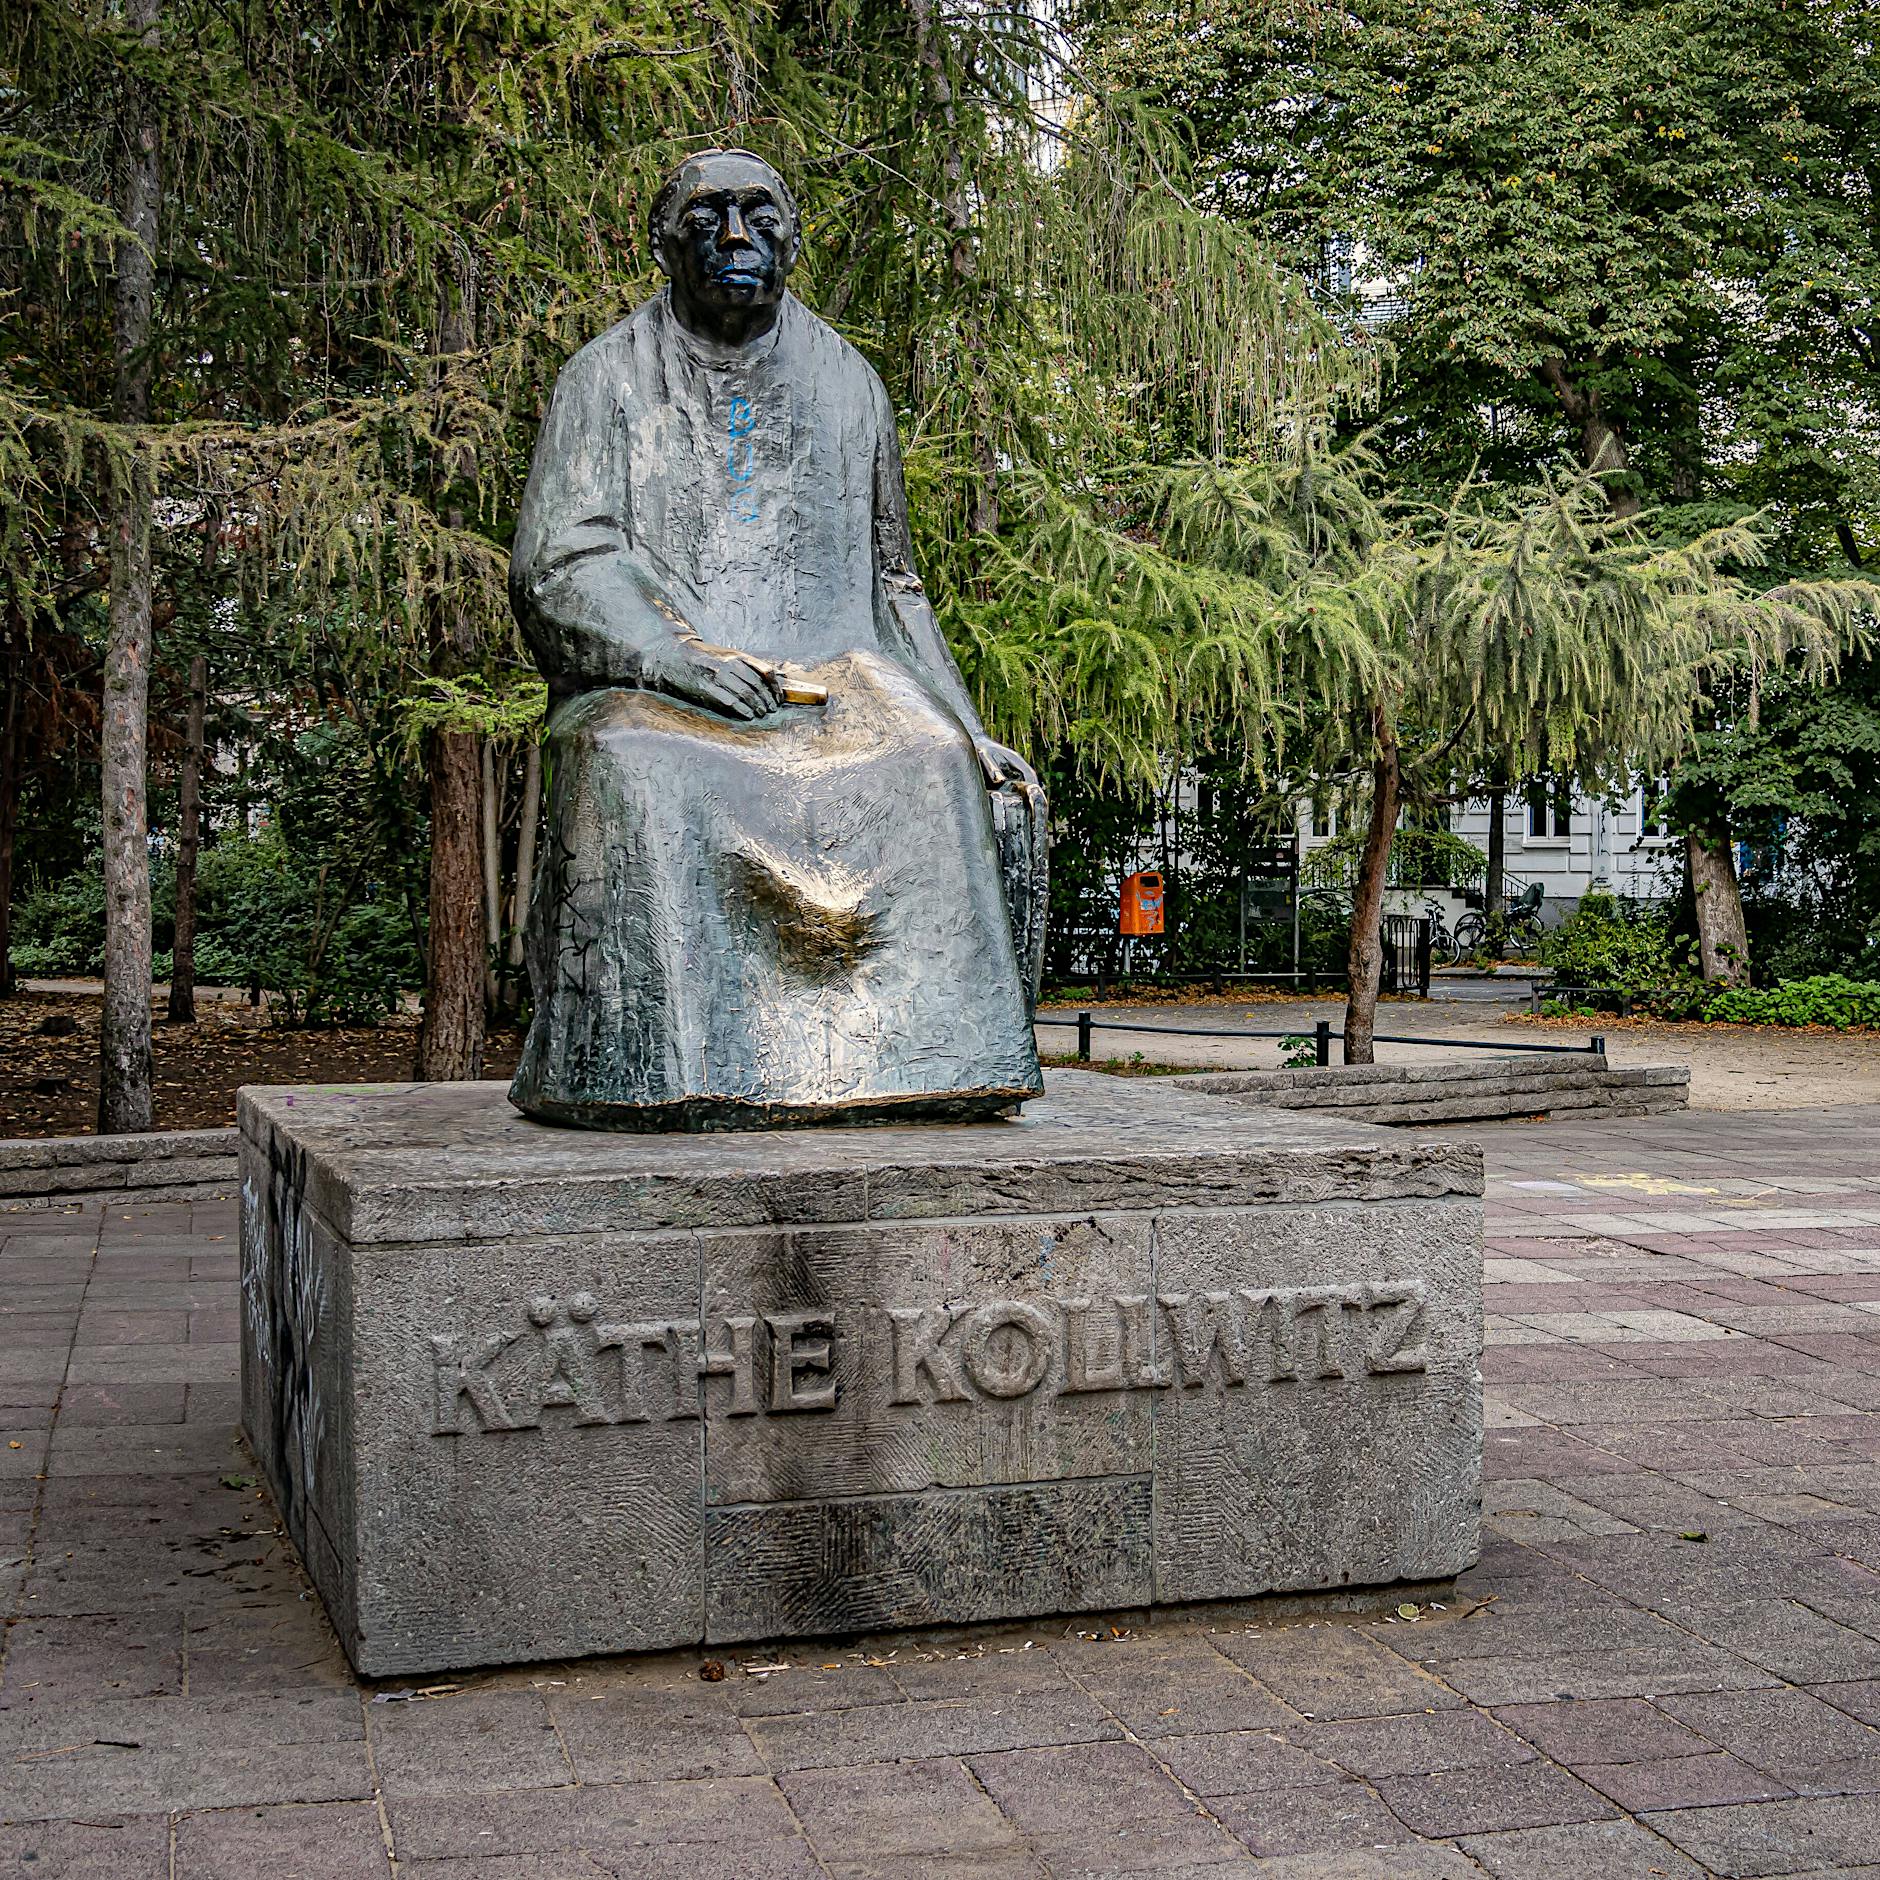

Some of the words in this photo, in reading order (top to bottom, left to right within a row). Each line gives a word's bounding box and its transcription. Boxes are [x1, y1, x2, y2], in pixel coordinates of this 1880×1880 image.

[1470, 797, 1523, 810] AVDA
[430, 1291, 837, 1437] KÄTHE
[886, 1281, 1429, 1407] KOLLWITZ
